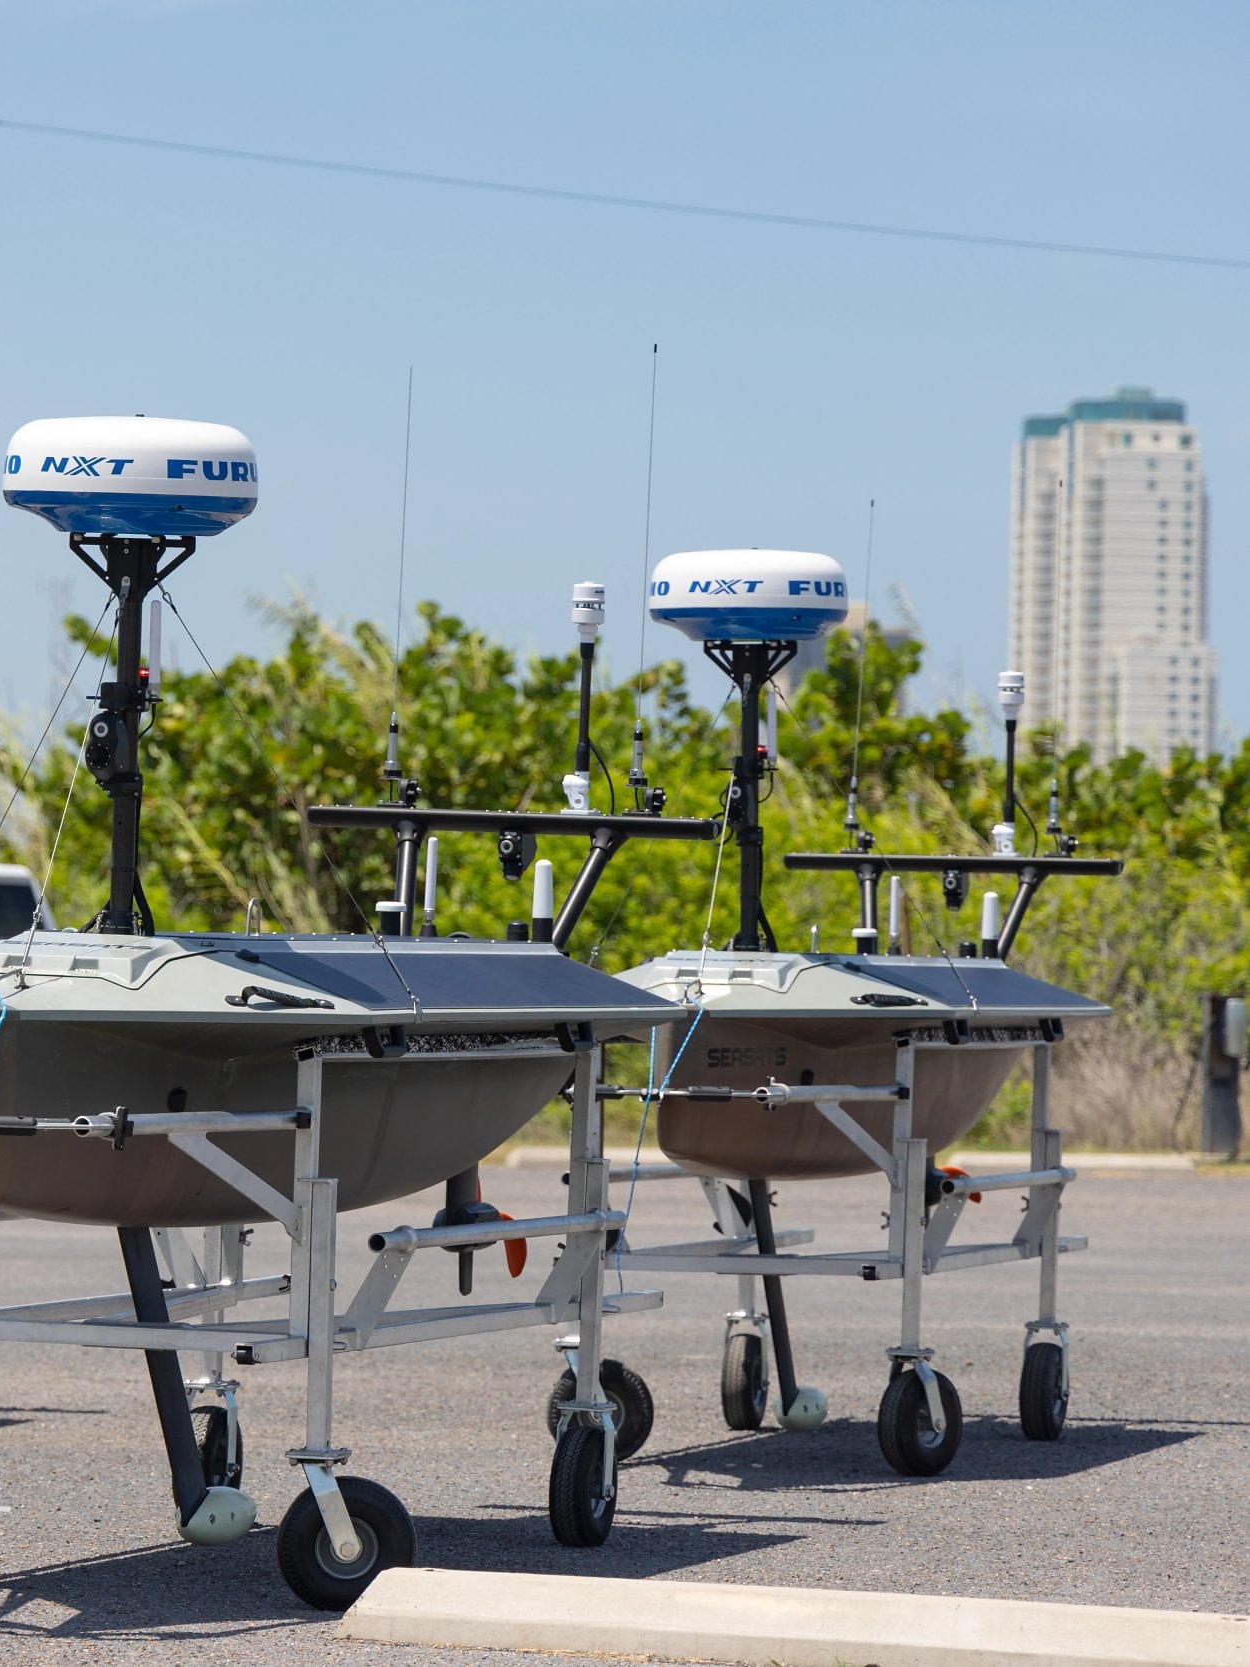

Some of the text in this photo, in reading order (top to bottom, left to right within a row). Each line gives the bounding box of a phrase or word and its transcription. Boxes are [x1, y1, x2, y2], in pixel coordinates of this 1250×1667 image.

[4, 454, 22, 475] O
[40, 455, 135, 477] NXT
[688, 579, 764, 595] NXT
[788, 580, 848, 598] FUR
[707, 1047, 788, 1069] SEASATS
